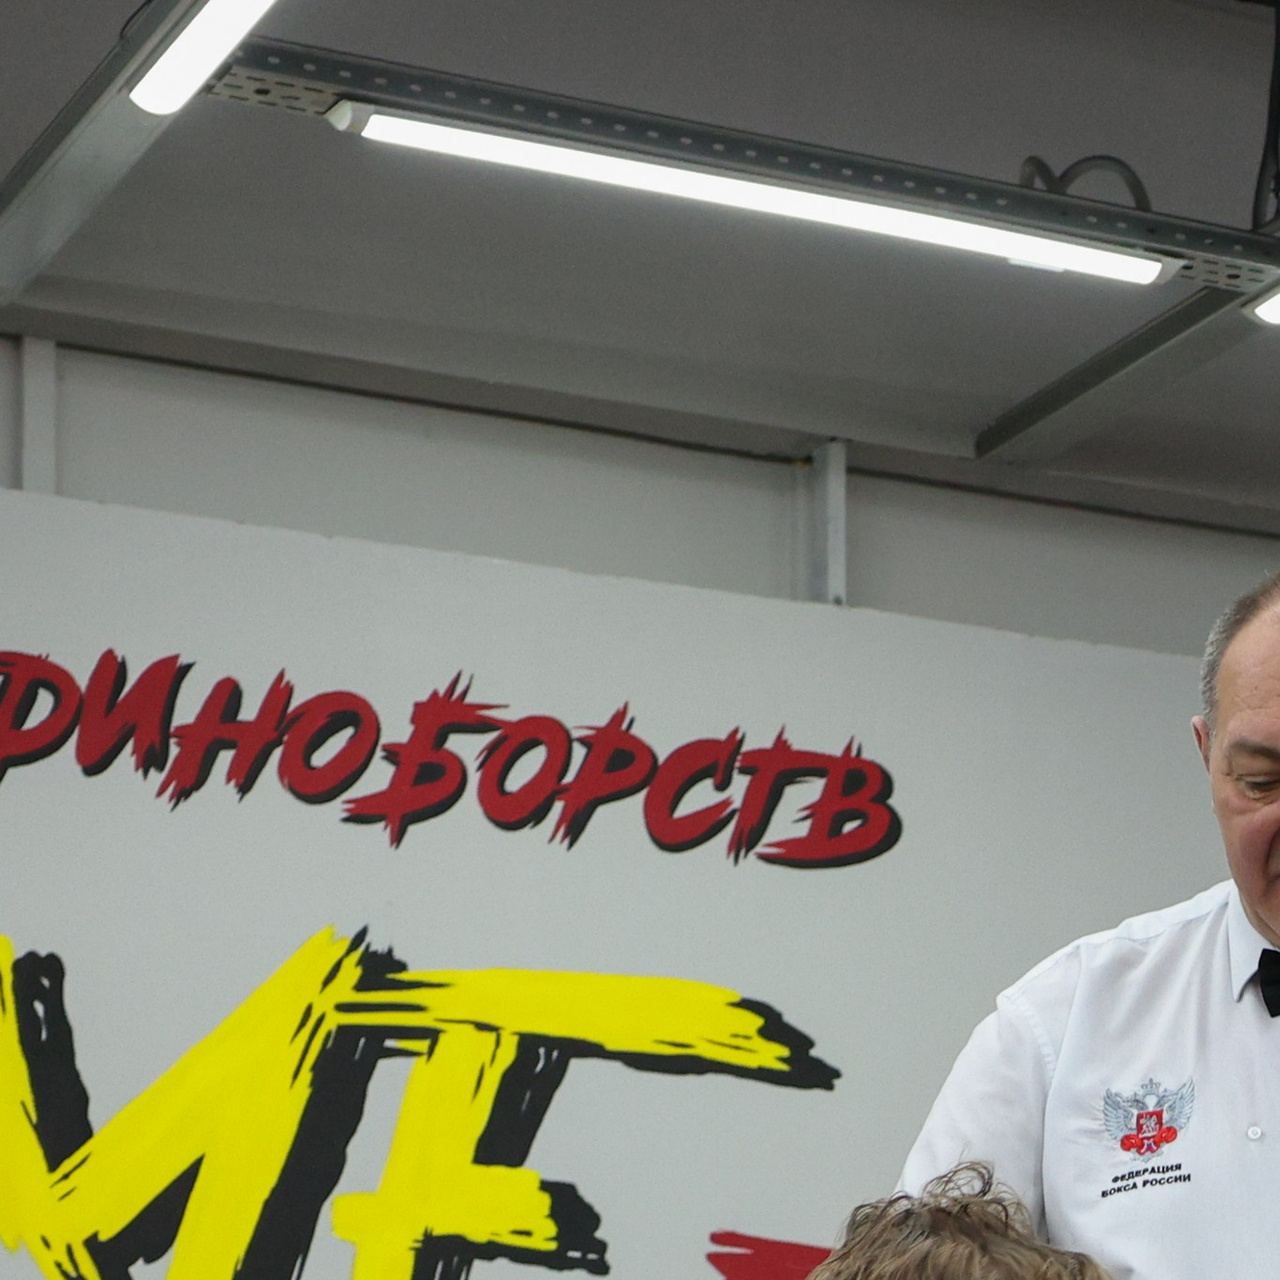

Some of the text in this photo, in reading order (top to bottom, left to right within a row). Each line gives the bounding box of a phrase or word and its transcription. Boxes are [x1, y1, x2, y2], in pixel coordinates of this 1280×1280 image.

[1111, 1163, 1182, 1183] ФЕДЕРАЦИЯ
[1101, 1173, 1191, 1198] БОКСА РОССИИ
